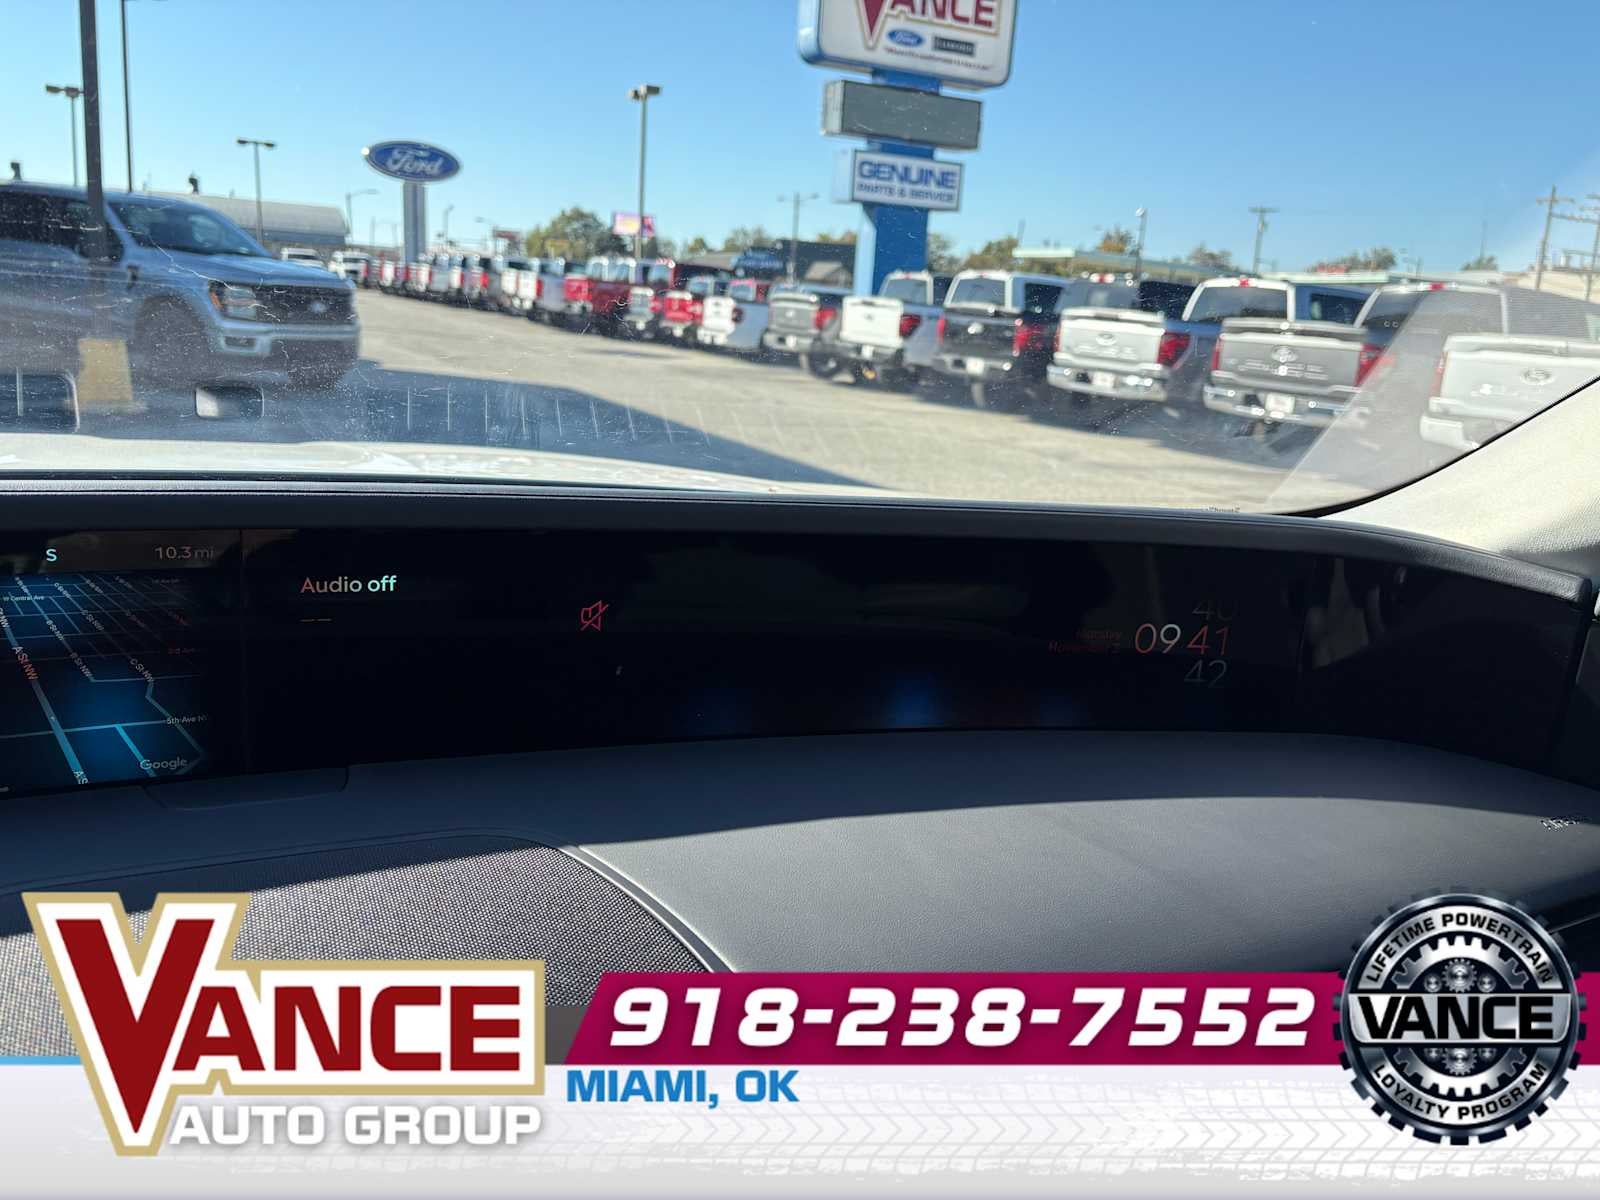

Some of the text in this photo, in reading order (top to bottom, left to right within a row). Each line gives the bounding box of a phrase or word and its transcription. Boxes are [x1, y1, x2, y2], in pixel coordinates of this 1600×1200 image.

[386, 147, 444, 176] Ford
[858, 160, 957, 189] GENUINE
[45, 548, 58, 562] S
[154, 546, 214, 560] 10.3 mi
[301, 575, 397, 593] Audio off
[1134, 623, 1182, 654] 09
[1187, 624, 1230, 656] 41
[1184, 659, 1228, 689] 42
[140, 756, 188, 771] Google
